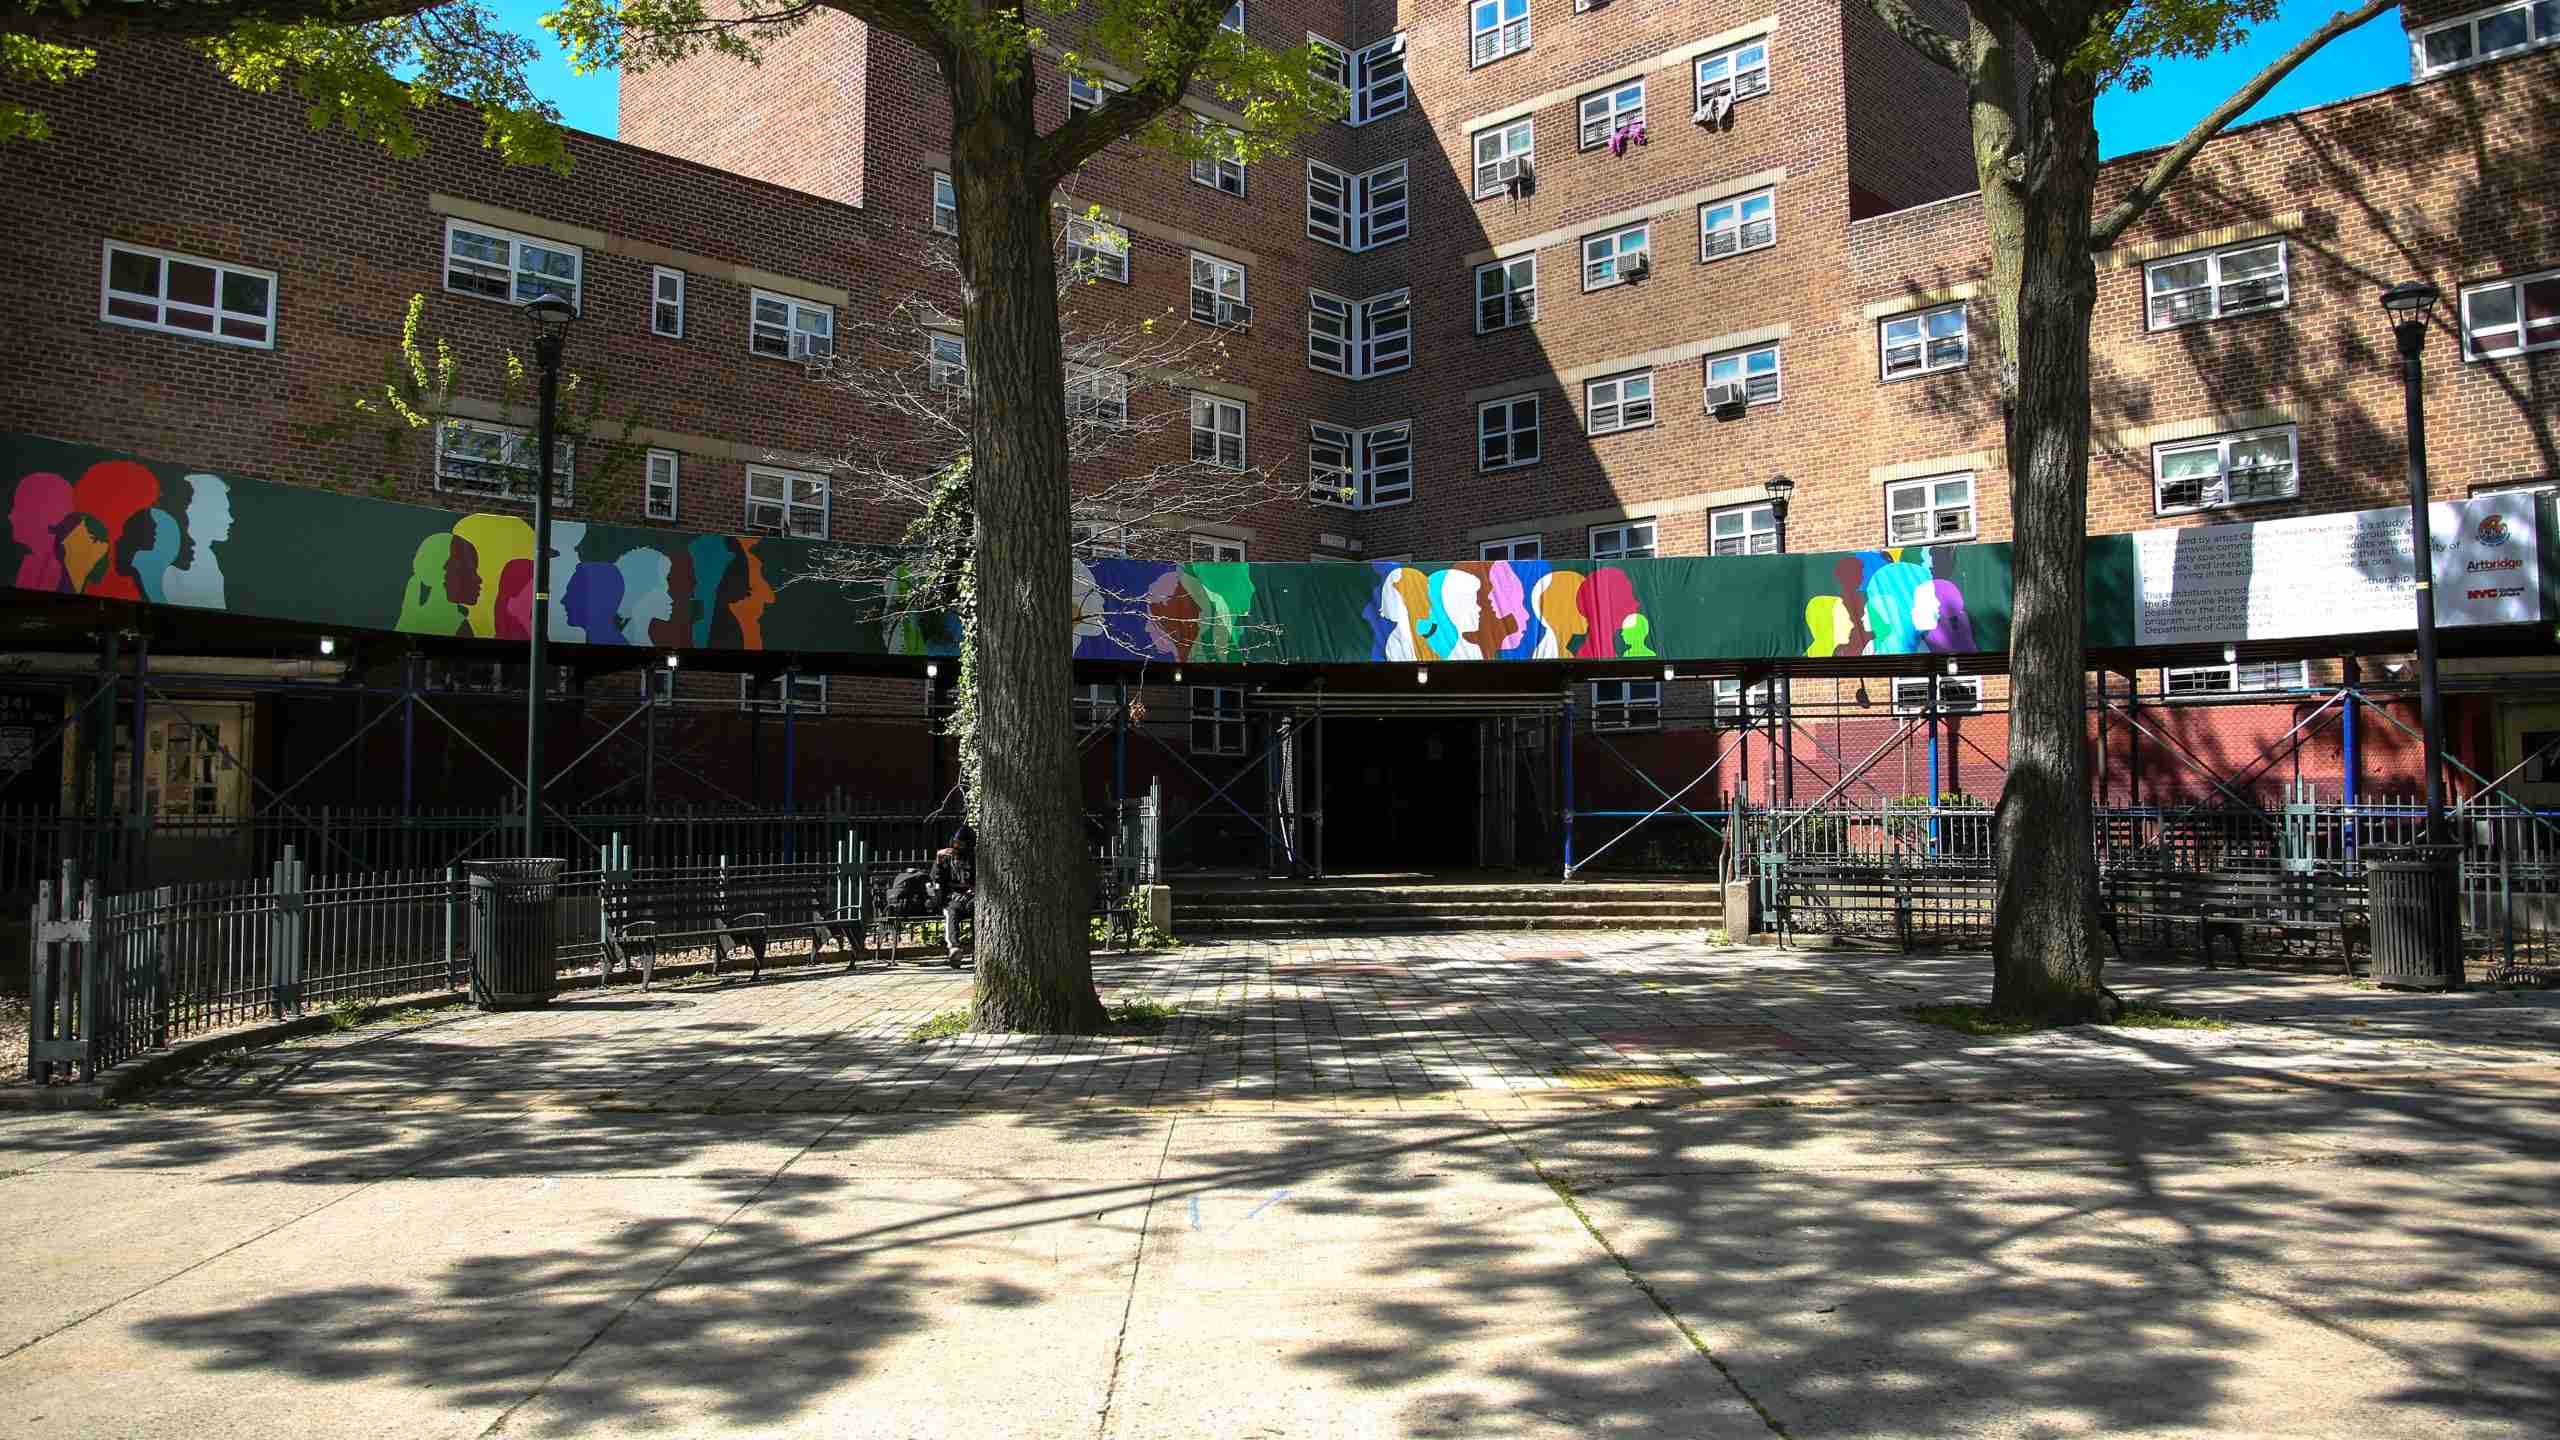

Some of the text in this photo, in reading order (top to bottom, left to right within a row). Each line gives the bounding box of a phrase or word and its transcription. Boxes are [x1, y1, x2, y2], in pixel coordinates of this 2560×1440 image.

[2375, 518, 2405, 530] study
[2467, 558, 2522, 571] Artbridge
[2144, 600, 2159, 610] the
[2162, 597, 2215, 609] Brownsville
[2217, 603, 2236, 615] City
[2145, 622, 2200, 634] Department
[2203, 621, 2213, 631] of
